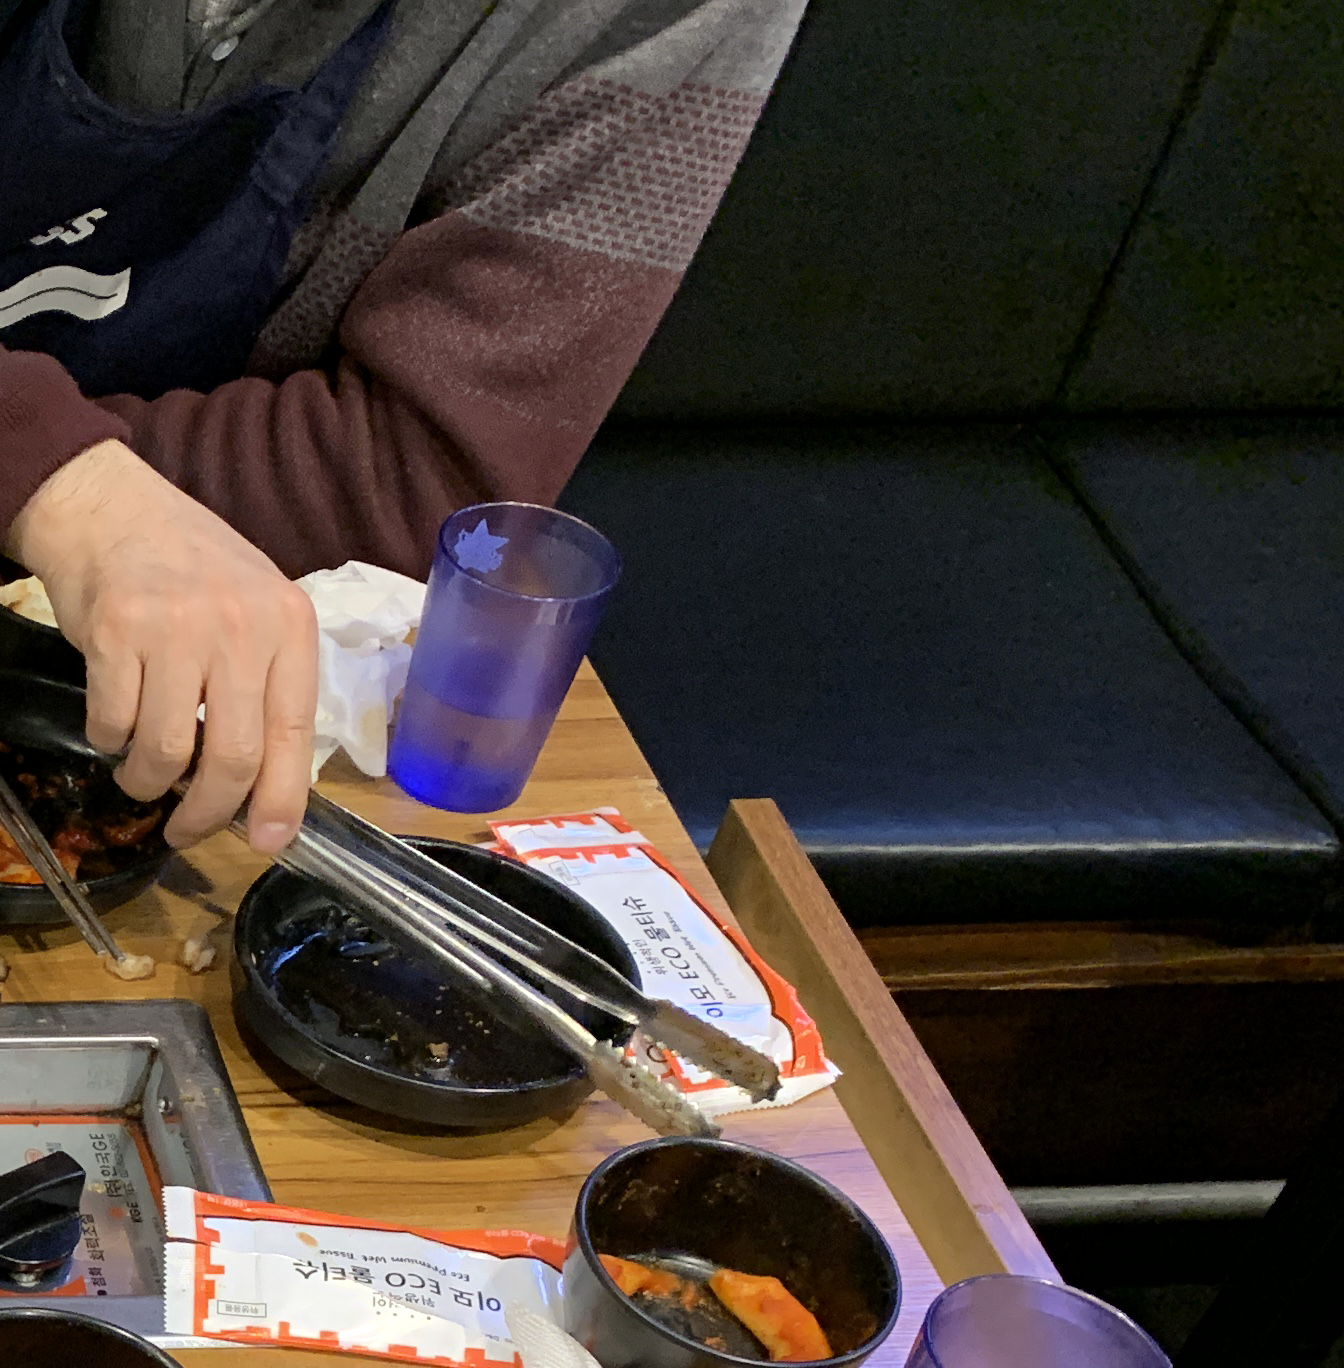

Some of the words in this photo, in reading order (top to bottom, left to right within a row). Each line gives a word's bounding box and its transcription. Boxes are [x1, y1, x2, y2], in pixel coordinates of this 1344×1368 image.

[661, 946, 699, 980] ECO
[689, 984, 723, 1018] 이모
[319, 1248, 358, 1260] Tissue
[364, 1252, 387, 1265] Wet
[390, 1254, 446, 1277] Premium
[385, 1272, 442, 1296] ECO
[449, 1286, 501, 1312] 이모
